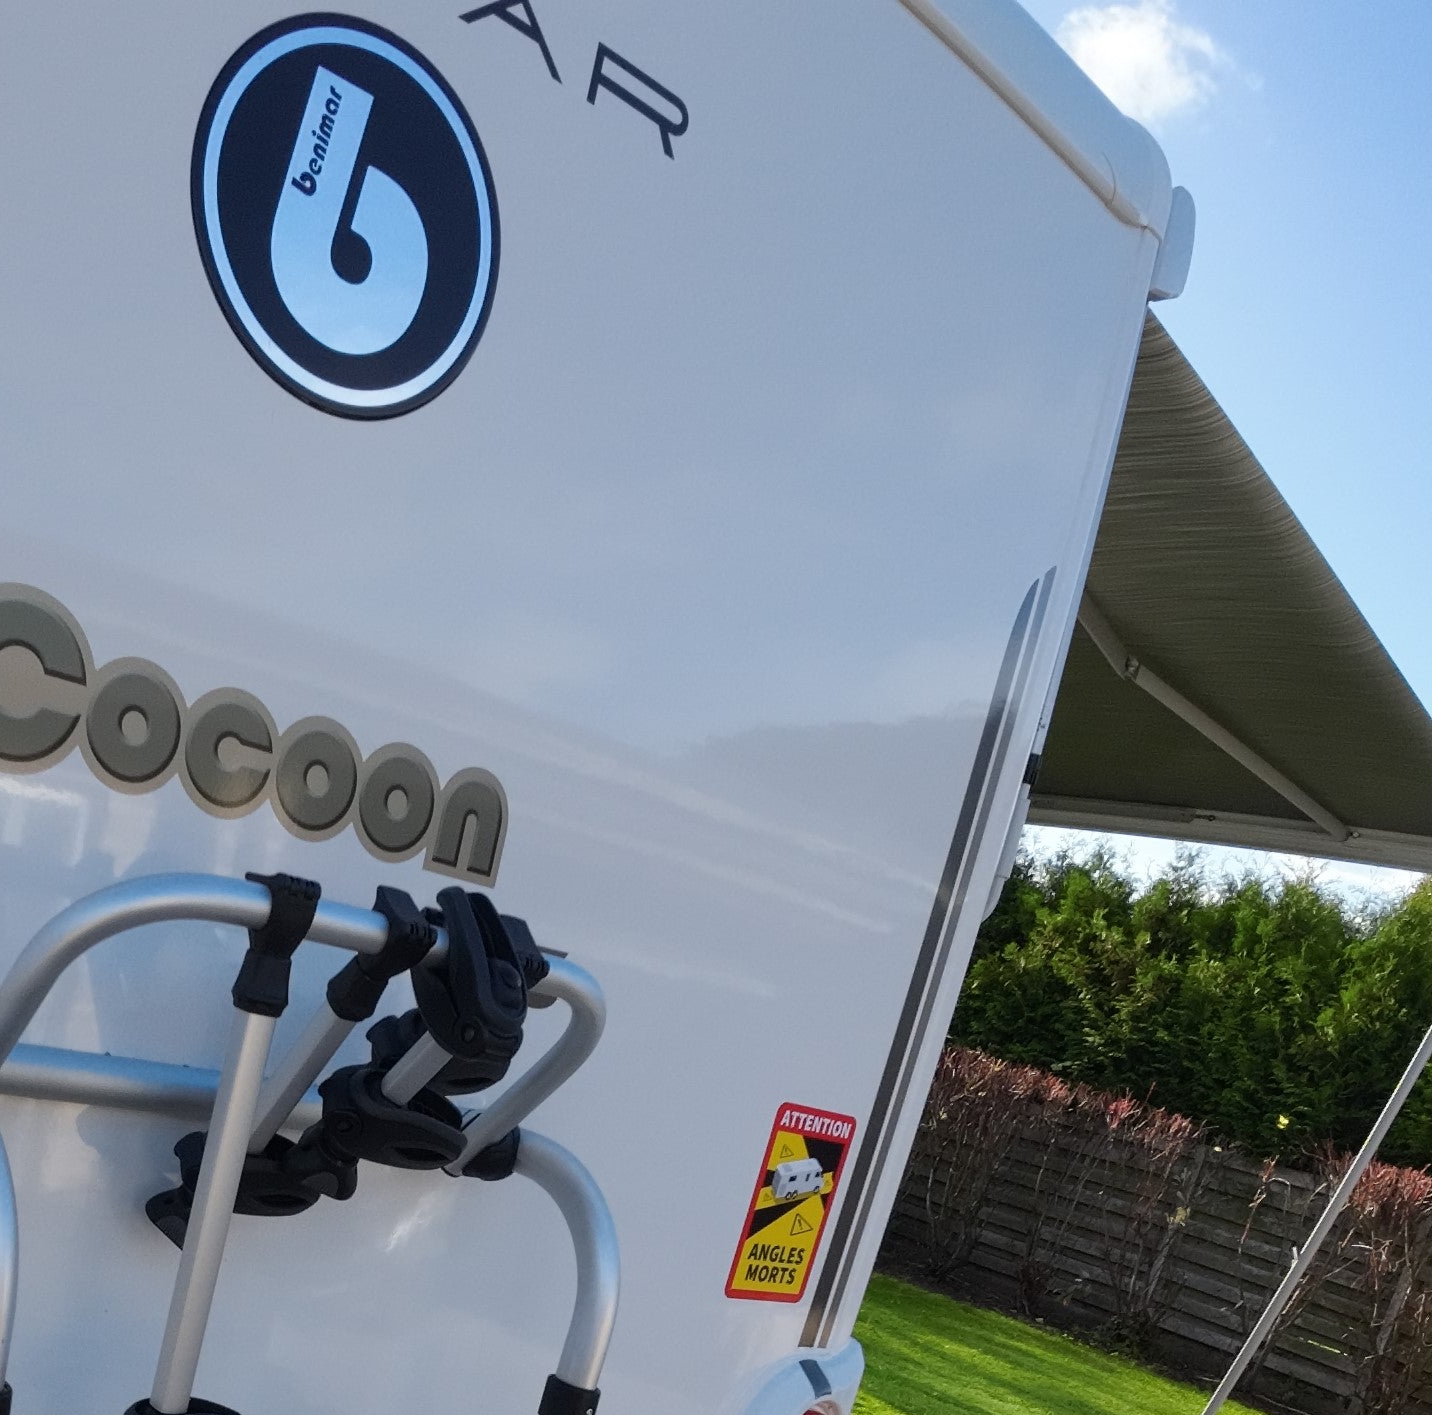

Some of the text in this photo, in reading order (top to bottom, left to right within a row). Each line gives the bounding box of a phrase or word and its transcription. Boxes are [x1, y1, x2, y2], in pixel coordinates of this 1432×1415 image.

[291, 85, 342, 197] benimar
[780, 1109, 852, 1139] ATTENTION
[747, 1243, 806, 1265] ANGLES
[744, 1264, 797, 1285] MORTS
